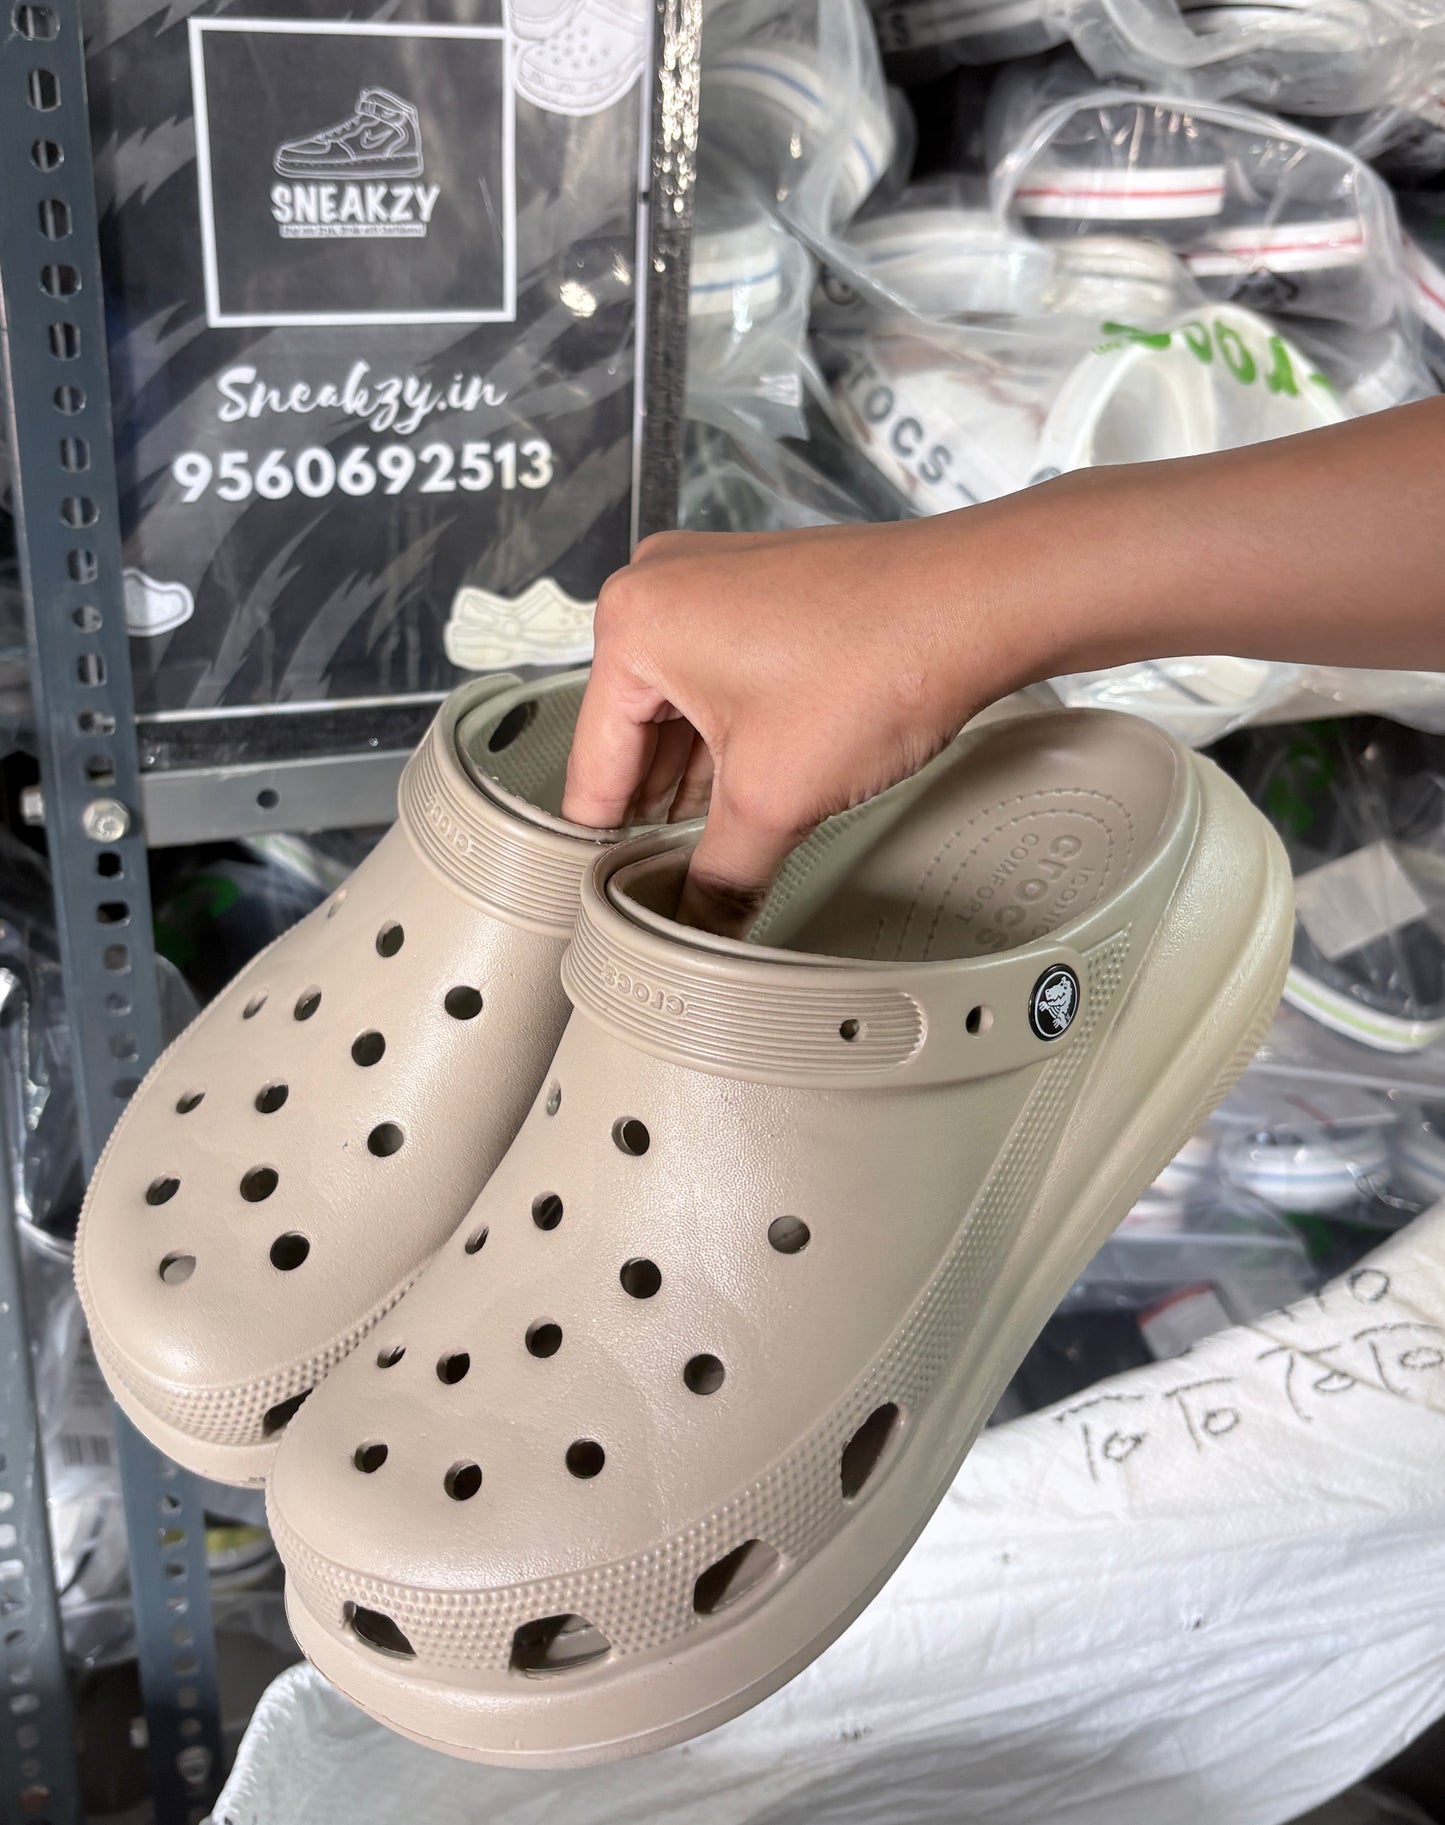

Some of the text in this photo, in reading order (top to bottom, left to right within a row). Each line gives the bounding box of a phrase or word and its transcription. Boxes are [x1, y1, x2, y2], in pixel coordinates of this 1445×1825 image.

[270, 182, 441, 224] SNEAKZY
[216, 358, 510, 433] Sneakzy.in
[172, 440, 554, 502] 9560692513
[426, 797, 469, 852] crocs
[954, 832, 1040, 926] COMFORT
[974, 834, 1082, 949] crocs
[604, 965, 685, 1017] crocs
